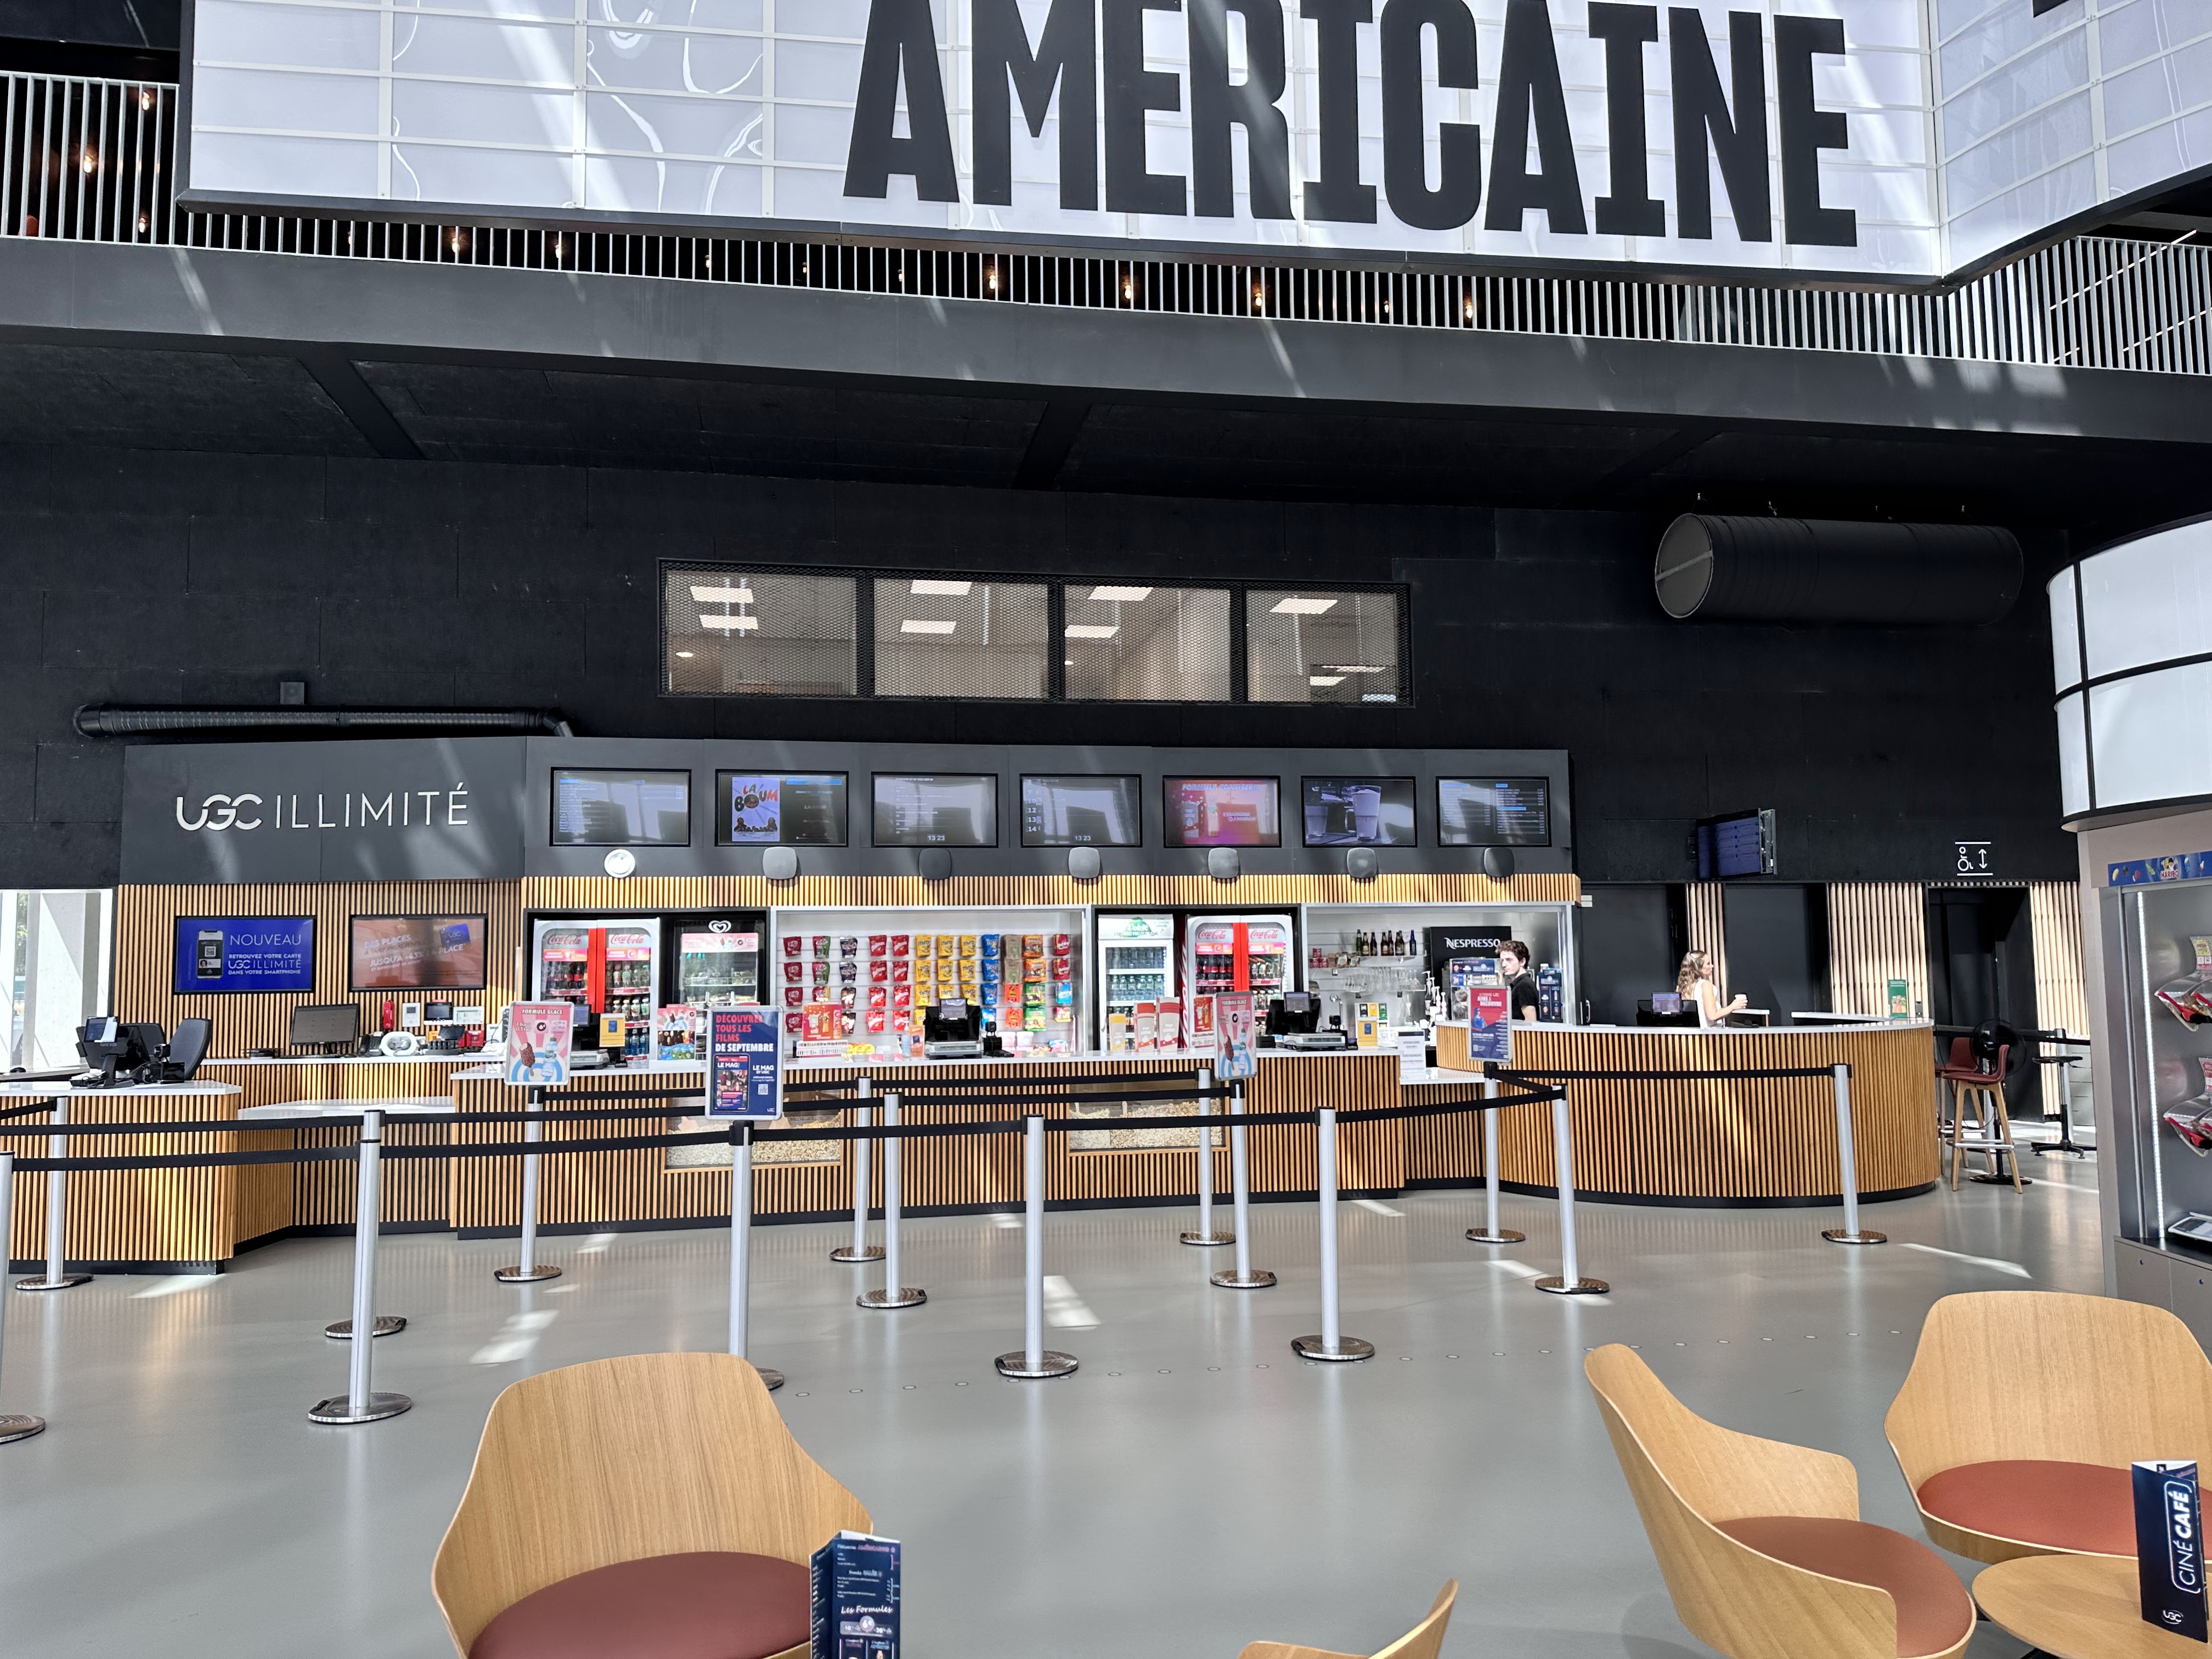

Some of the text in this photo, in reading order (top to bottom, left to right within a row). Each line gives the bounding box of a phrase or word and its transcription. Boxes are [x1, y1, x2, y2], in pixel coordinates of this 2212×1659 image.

[743, 783, 757, 794] LA
[176, 782, 469, 831] UGC ILLIMITÉ
[2161, 870, 2179, 878] HARIBO
[229, 934, 301, 945] NOUVEAU
[364, 934, 411, 949] DES PLACES
[1443, 937, 1500, 950] NESPRESSO
[228, 958, 301, 969] UGC ILLIMITÉ
[715, 1013, 764, 1023] DÉCOUVREZ
[715, 1024, 752, 1032] TOUS LES
[715, 1034, 740, 1042] FILMS
[715, 1043, 774, 1052] DE SEPTEMBRE
[2168, 1491, 2196, 1585] CINÉ CAFÉ
[856, 1605, 893, 1613] Formules
